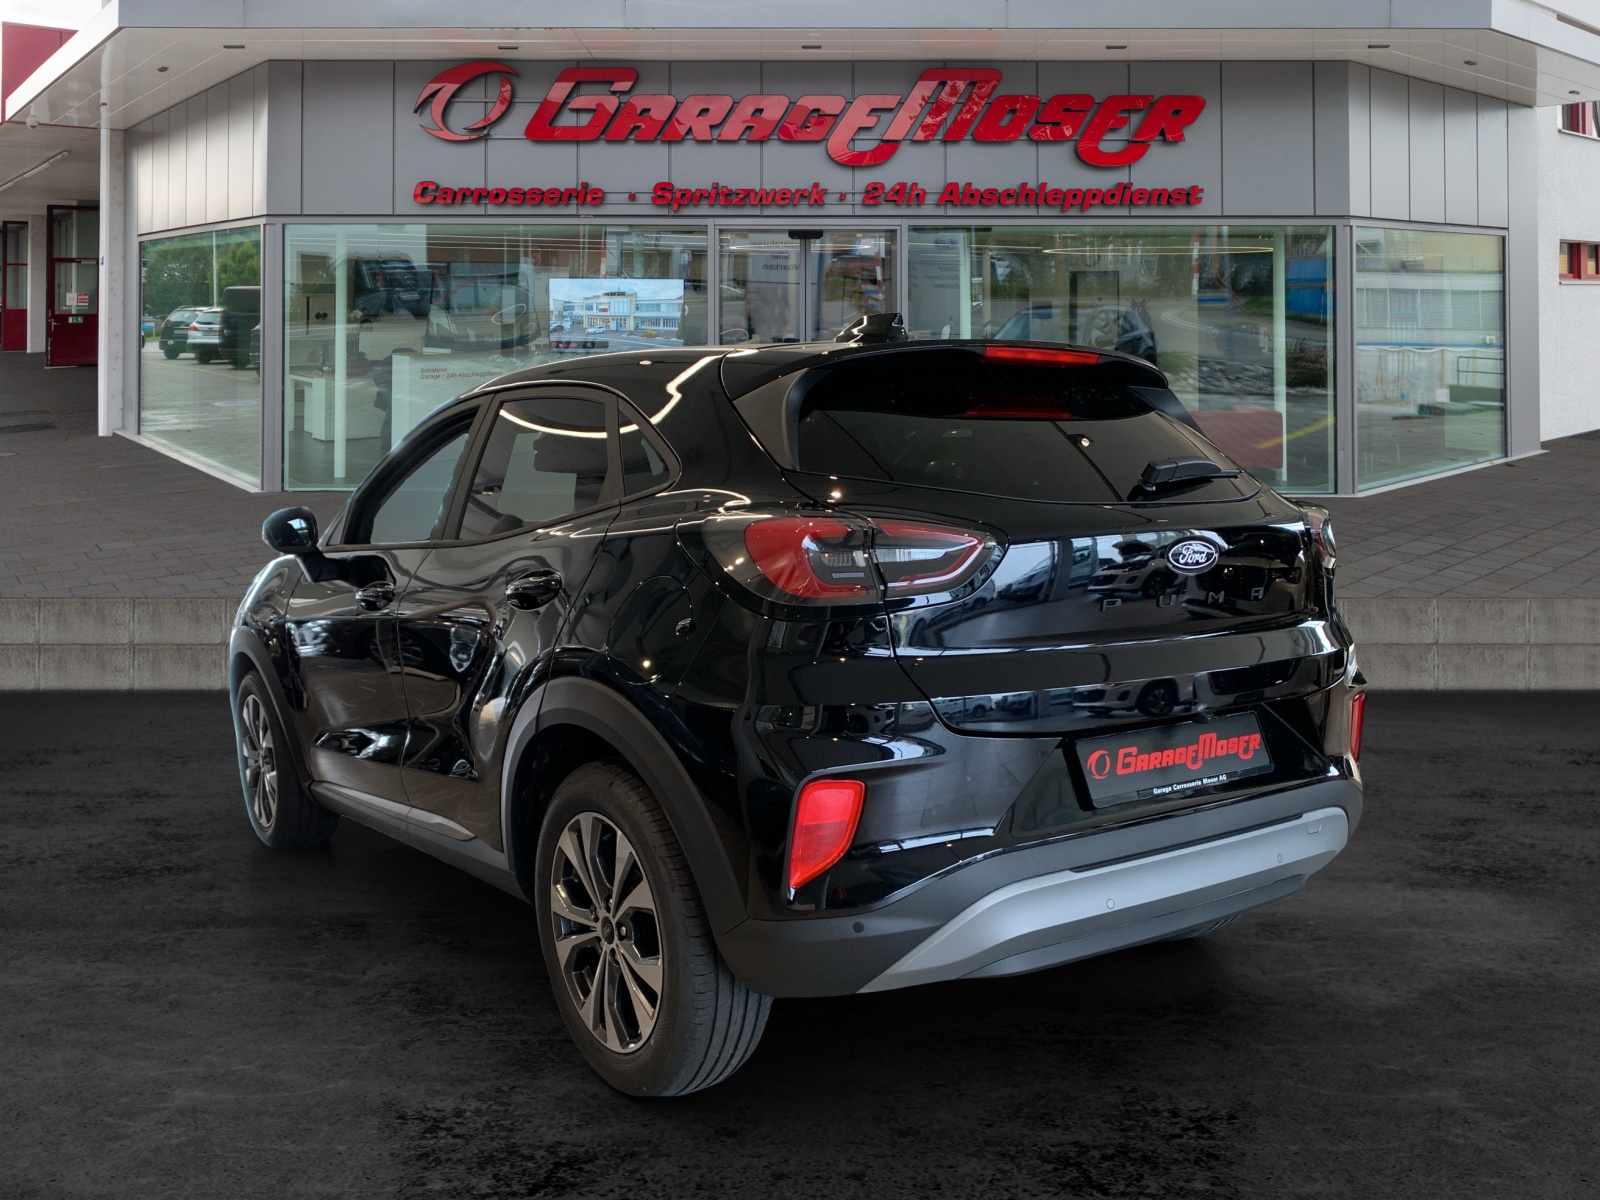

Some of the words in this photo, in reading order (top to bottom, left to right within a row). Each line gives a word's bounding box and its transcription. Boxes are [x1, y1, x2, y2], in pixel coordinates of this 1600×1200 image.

[413, 181, 604, 205] Carrosserie
[651, 182, 826, 211] Spritzwerk
[862, 182, 926, 205] 24h
[938, 182, 1204, 211] Abschleppdienst
[458, 370, 503, 378] Abschleppdienst
[1179, 545, 1208, 564] Ford
[1101, 586, 1264, 612] PUMA
[1153, 785, 1172, 795] Garage
[1173, 780, 1202, 791] Carrosserie
[1203, 776, 1218, 785] Moser
